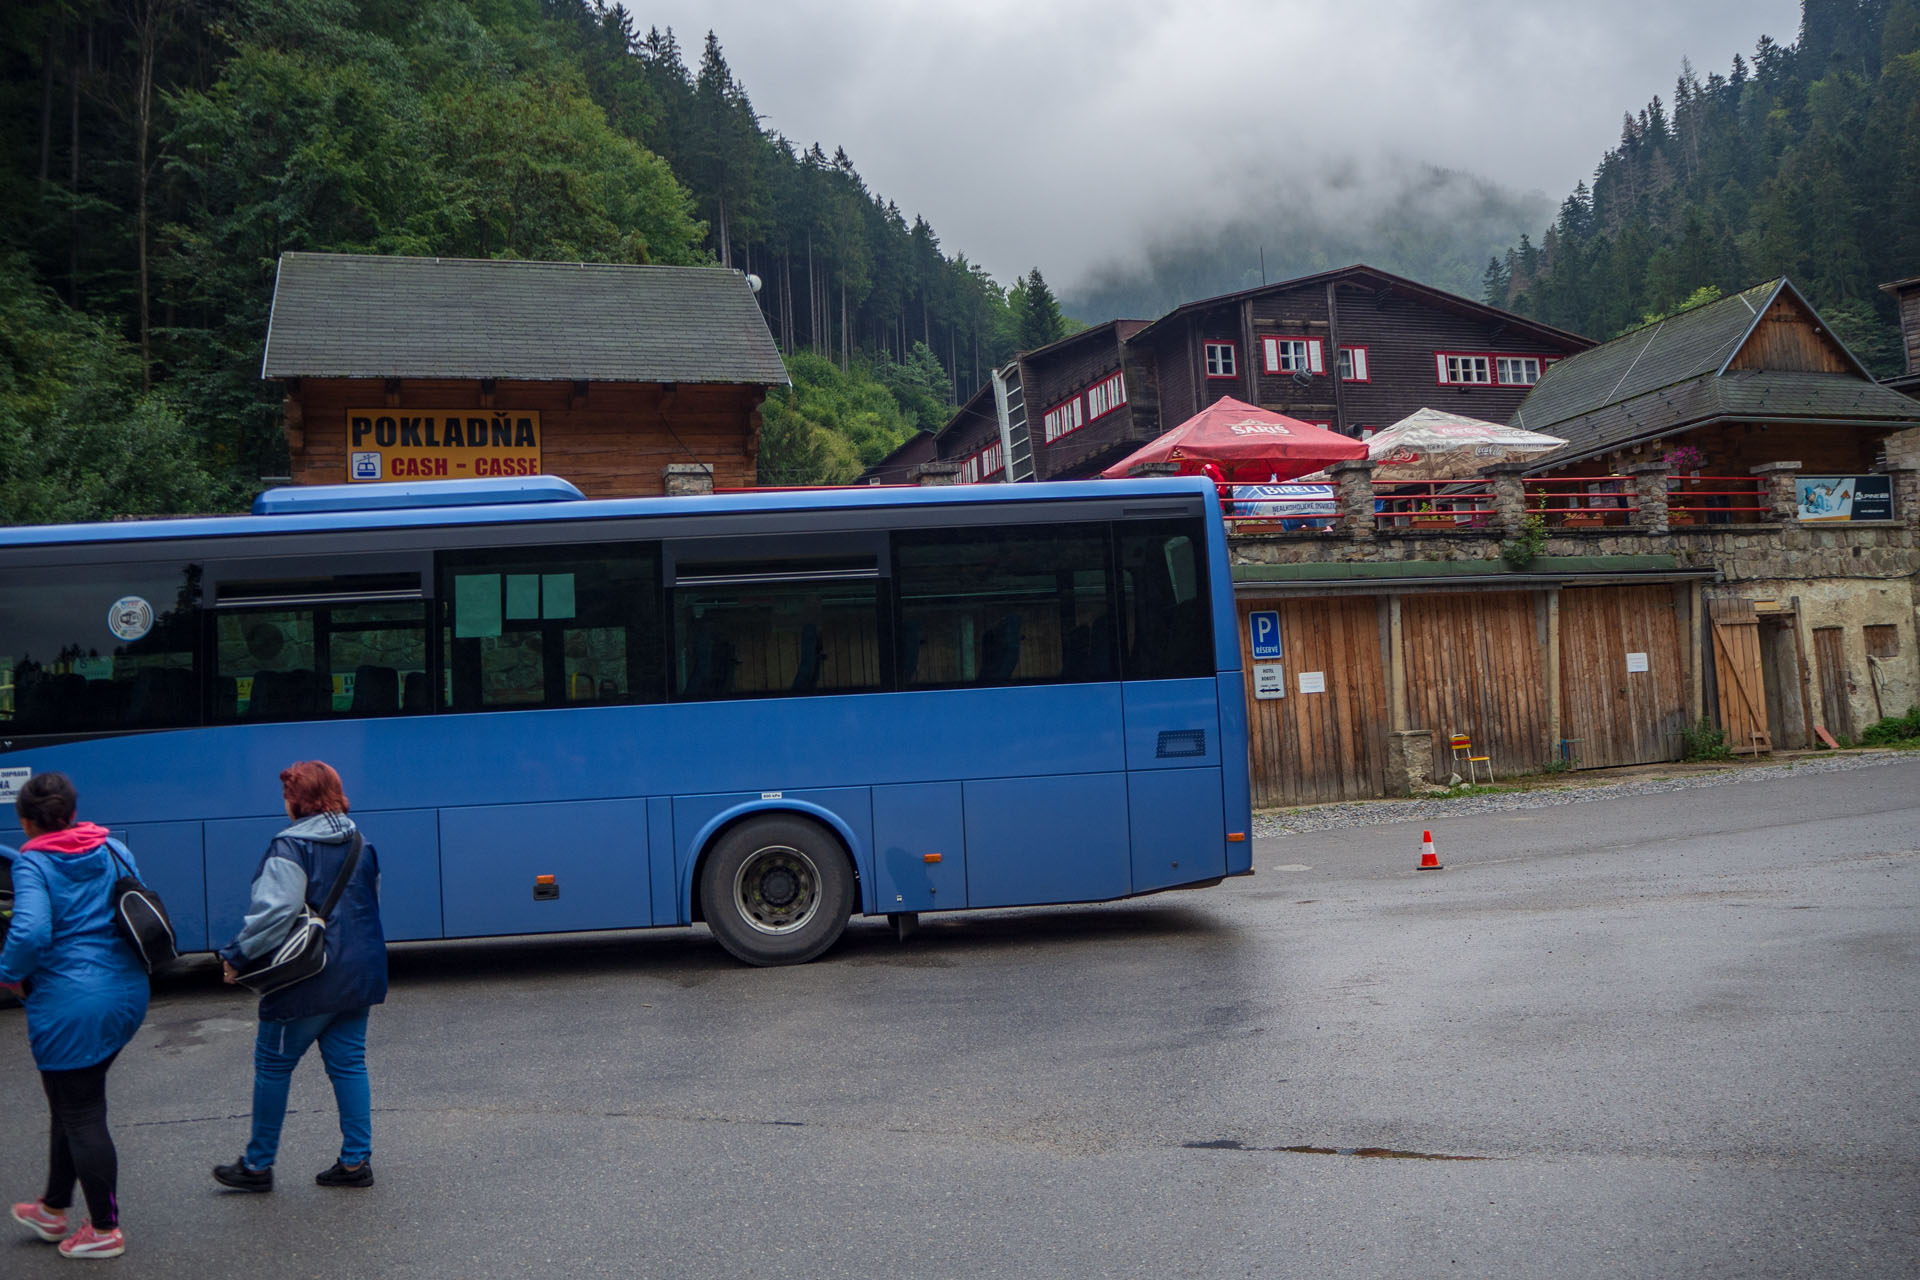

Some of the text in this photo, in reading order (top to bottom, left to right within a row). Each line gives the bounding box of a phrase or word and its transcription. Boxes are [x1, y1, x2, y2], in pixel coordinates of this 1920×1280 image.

[351, 411, 537, 447] POKLADŇA
[391, 457, 448, 476] CASH
[475, 457, 537, 476] CASSE
[1264, 485, 1325, 495] BIRELL
[1258, 617, 1271, 643] P
